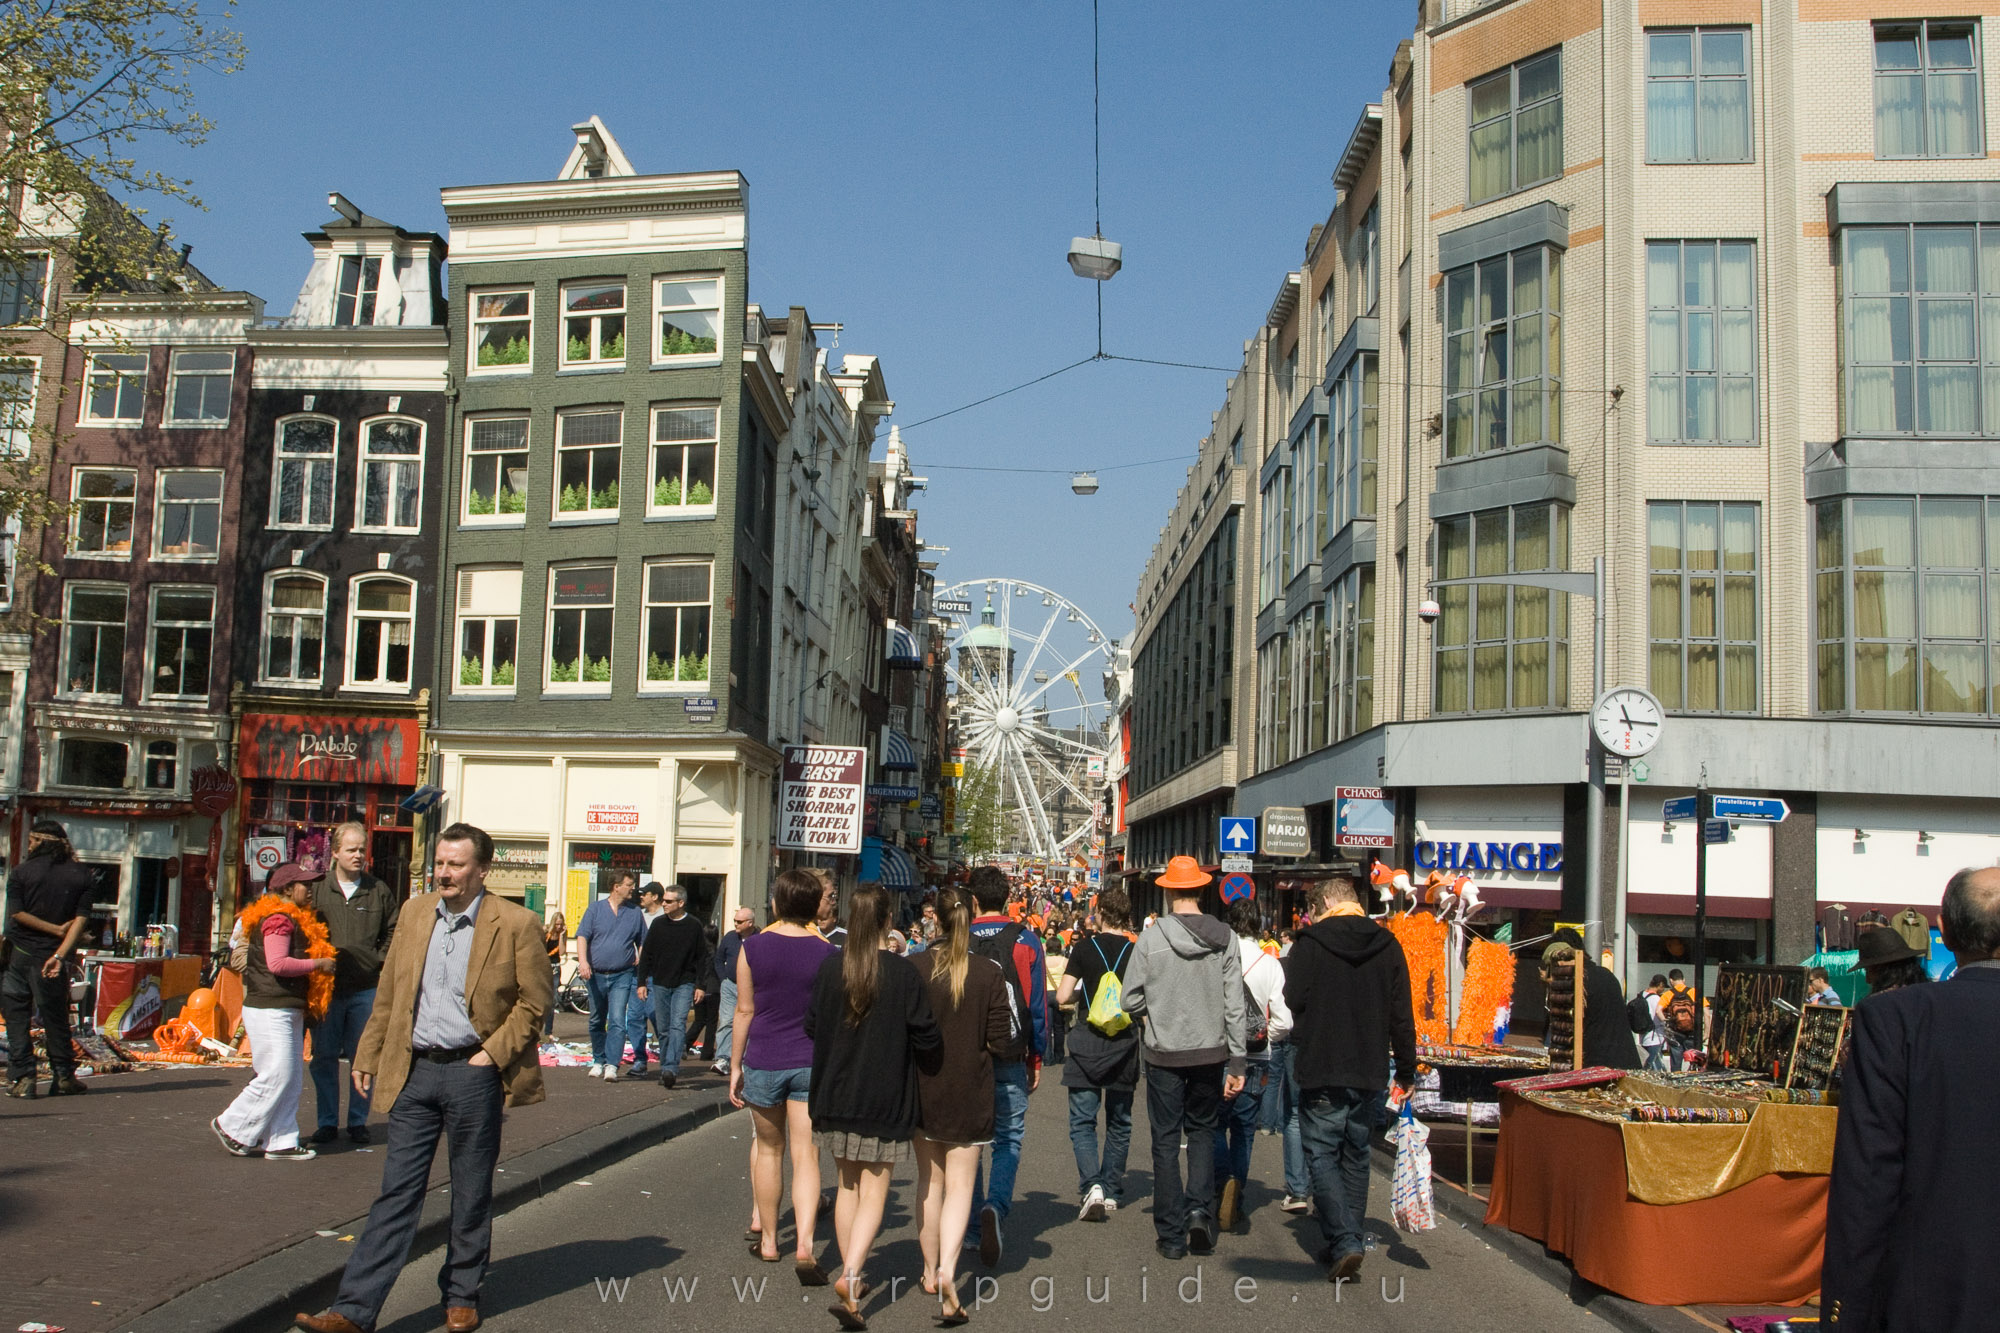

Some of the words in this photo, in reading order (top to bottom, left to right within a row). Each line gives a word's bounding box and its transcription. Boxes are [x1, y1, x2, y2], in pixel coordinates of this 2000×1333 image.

[939, 602, 970, 611] HOTEL
[790, 750, 857, 766] MIDDLE
[800, 766, 845, 781] EAST
[788, 785, 815, 798] THE
[819, 787, 855, 800] BEST
[867, 788, 917, 798] ARGENTINOS
[1343, 788, 1385, 799] CHANGE
[785, 800, 856, 815] SHOARMA
[1716, 798, 1756, 807] Amstelkring
[588, 813, 596, 822] DE
[790, 815, 850, 829] FALAFEL
[1270, 813, 1305, 823] drogisterij
[1268, 824, 1306, 837] MARJO
[787, 830, 804, 842] IN
[809, 831, 851, 844] TOWN
[1342, 836, 1385, 846] CHANGE
[1267, 840, 1306, 848] parfumerie
[509, 848, 542, 857] QUALITY
[574, 851, 598, 860] HIGH
[612, 852, 647, 861] QUALITY
[1414, 841, 1563, 872] CHANGE
[260, 853, 276, 863] 30
[130, 996, 160, 1026] AMSTEL
